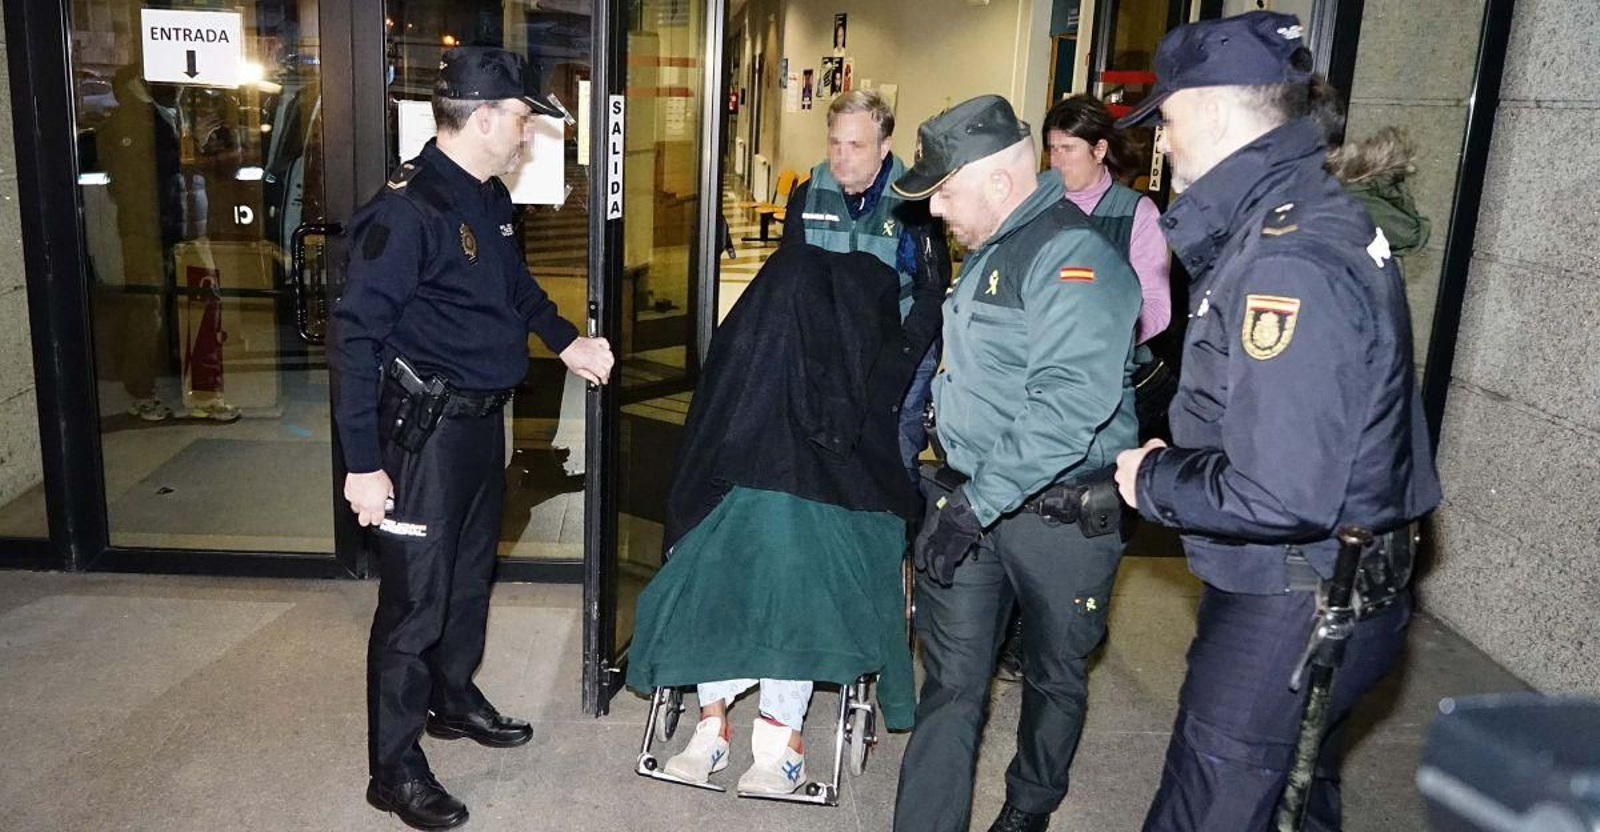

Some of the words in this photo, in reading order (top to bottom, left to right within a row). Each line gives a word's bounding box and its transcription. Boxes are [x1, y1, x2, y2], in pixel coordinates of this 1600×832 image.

[150, 26, 230, 43] ENTRADA
[610, 100, 622, 214] SALIDA
[1151, 126, 1164, 188] LIDA
